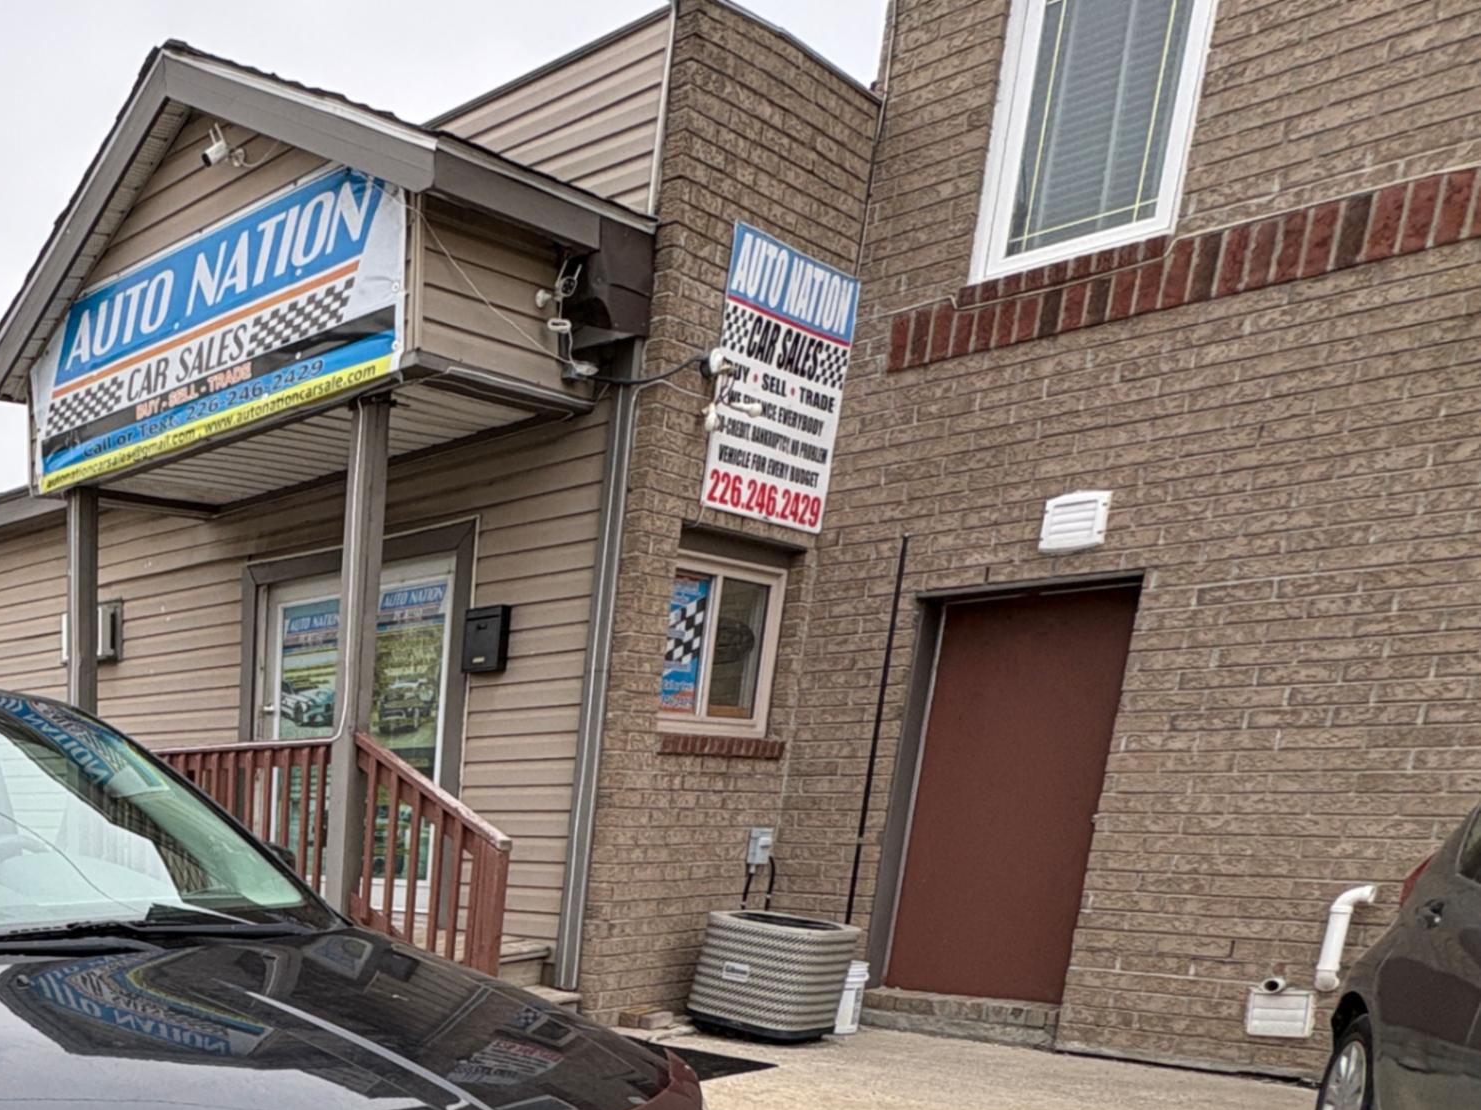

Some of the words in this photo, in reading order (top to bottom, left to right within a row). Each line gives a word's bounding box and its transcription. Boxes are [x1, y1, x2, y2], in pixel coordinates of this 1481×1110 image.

[65, 269, 174, 371] AUTO
[186, 176, 374, 317] NATION
[731, 232, 790, 309] AUTO
[782, 255, 855, 336] NATION
[127, 357, 168, 401] CAR
[176, 323, 248, 383] SALES
[746, 315, 781, 365] CAR
[776, 328, 824, 381] SALES
[136, 399, 162, 421] BUY
[168, 384, 199, 408] SELL
[207, 361, 252, 392] TRADE
[743, 394, 777, 421] FINNCE
[777, 407, 825, 437] EVERYBODY
[761, 372, 786, 397] SELL
[799, 386, 835, 413] TRADE
[83, 438, 111, 458] Call
[116, 433, 132, 446] or
[718, 443, 751, 469] VEHICLE
[751, 453, 767, 474] FOR
[767, 459, 789, 480] EVERY
[789, 465, 819, 489] BUDGET
[707, 468, 822, 528] 226.246.2429
